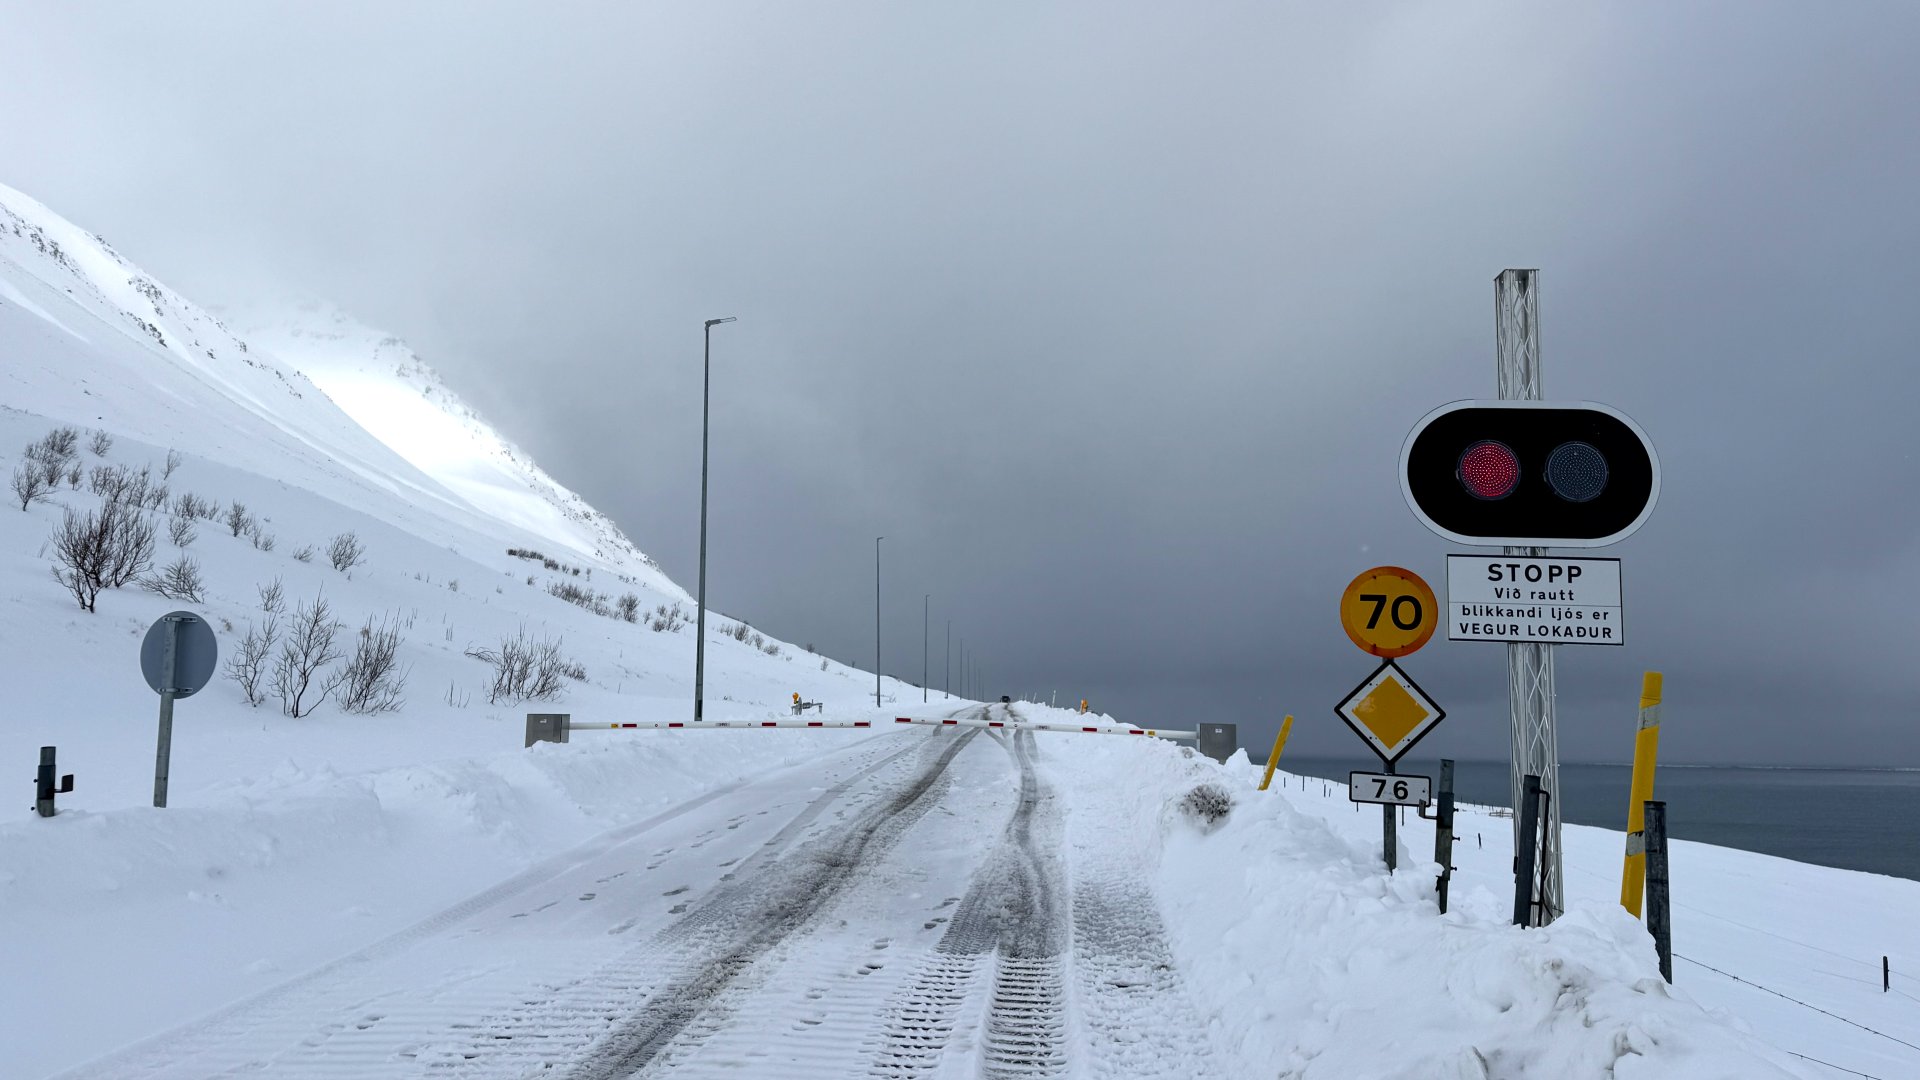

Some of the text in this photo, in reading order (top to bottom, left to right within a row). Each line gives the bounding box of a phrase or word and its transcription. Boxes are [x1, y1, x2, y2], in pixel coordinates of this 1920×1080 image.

[1487, 563, 1583, 584] STOPP
[1494, 587, 1575, 601] Við rautt
[1360, 594, 1423, 630] 70
[1461, 605, 1609, 622] blikkandi ljós er
[1459, 622, 1612, 639] VEGUR LOKAÐUR
[1371, 778, 1409, 802] 76
